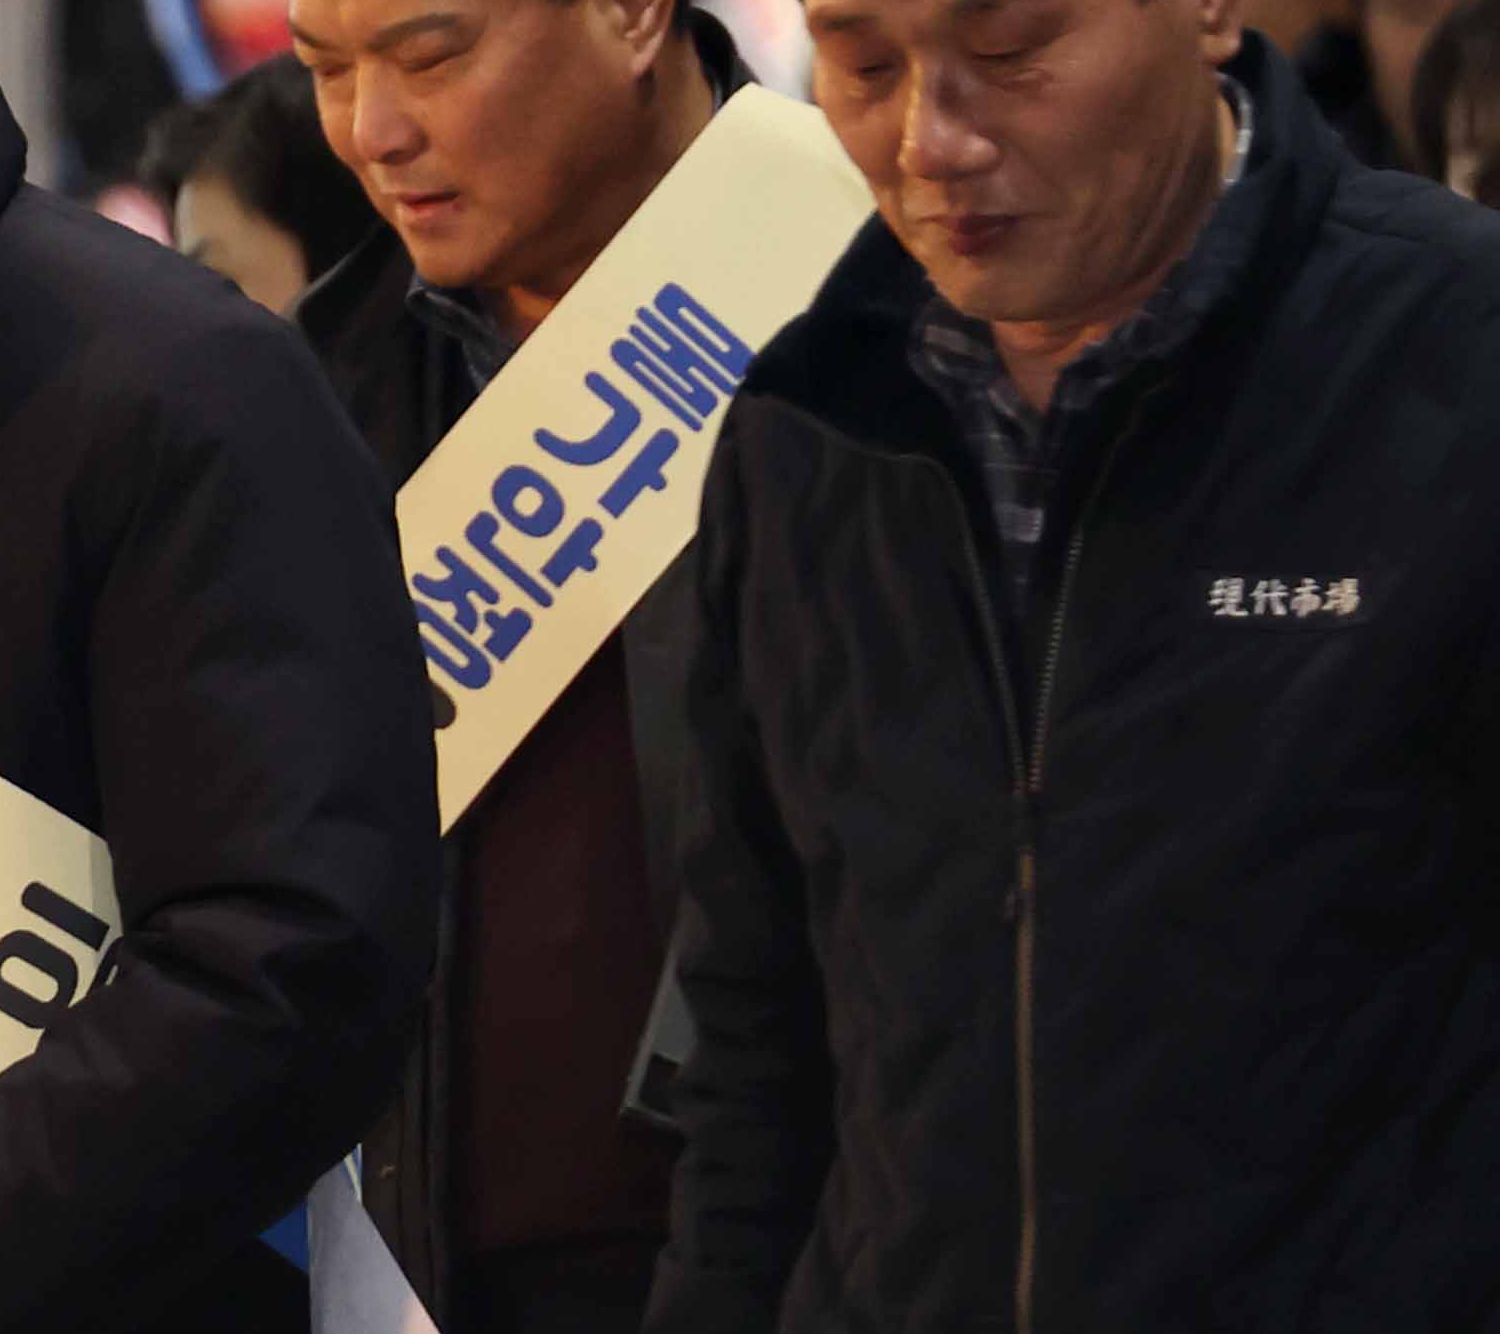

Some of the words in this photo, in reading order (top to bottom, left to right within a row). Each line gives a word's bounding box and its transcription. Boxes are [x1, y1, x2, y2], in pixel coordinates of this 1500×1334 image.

[411, 282, 757, 690] 물가안정
[1207, 577, 1362, 617] 現代市場
